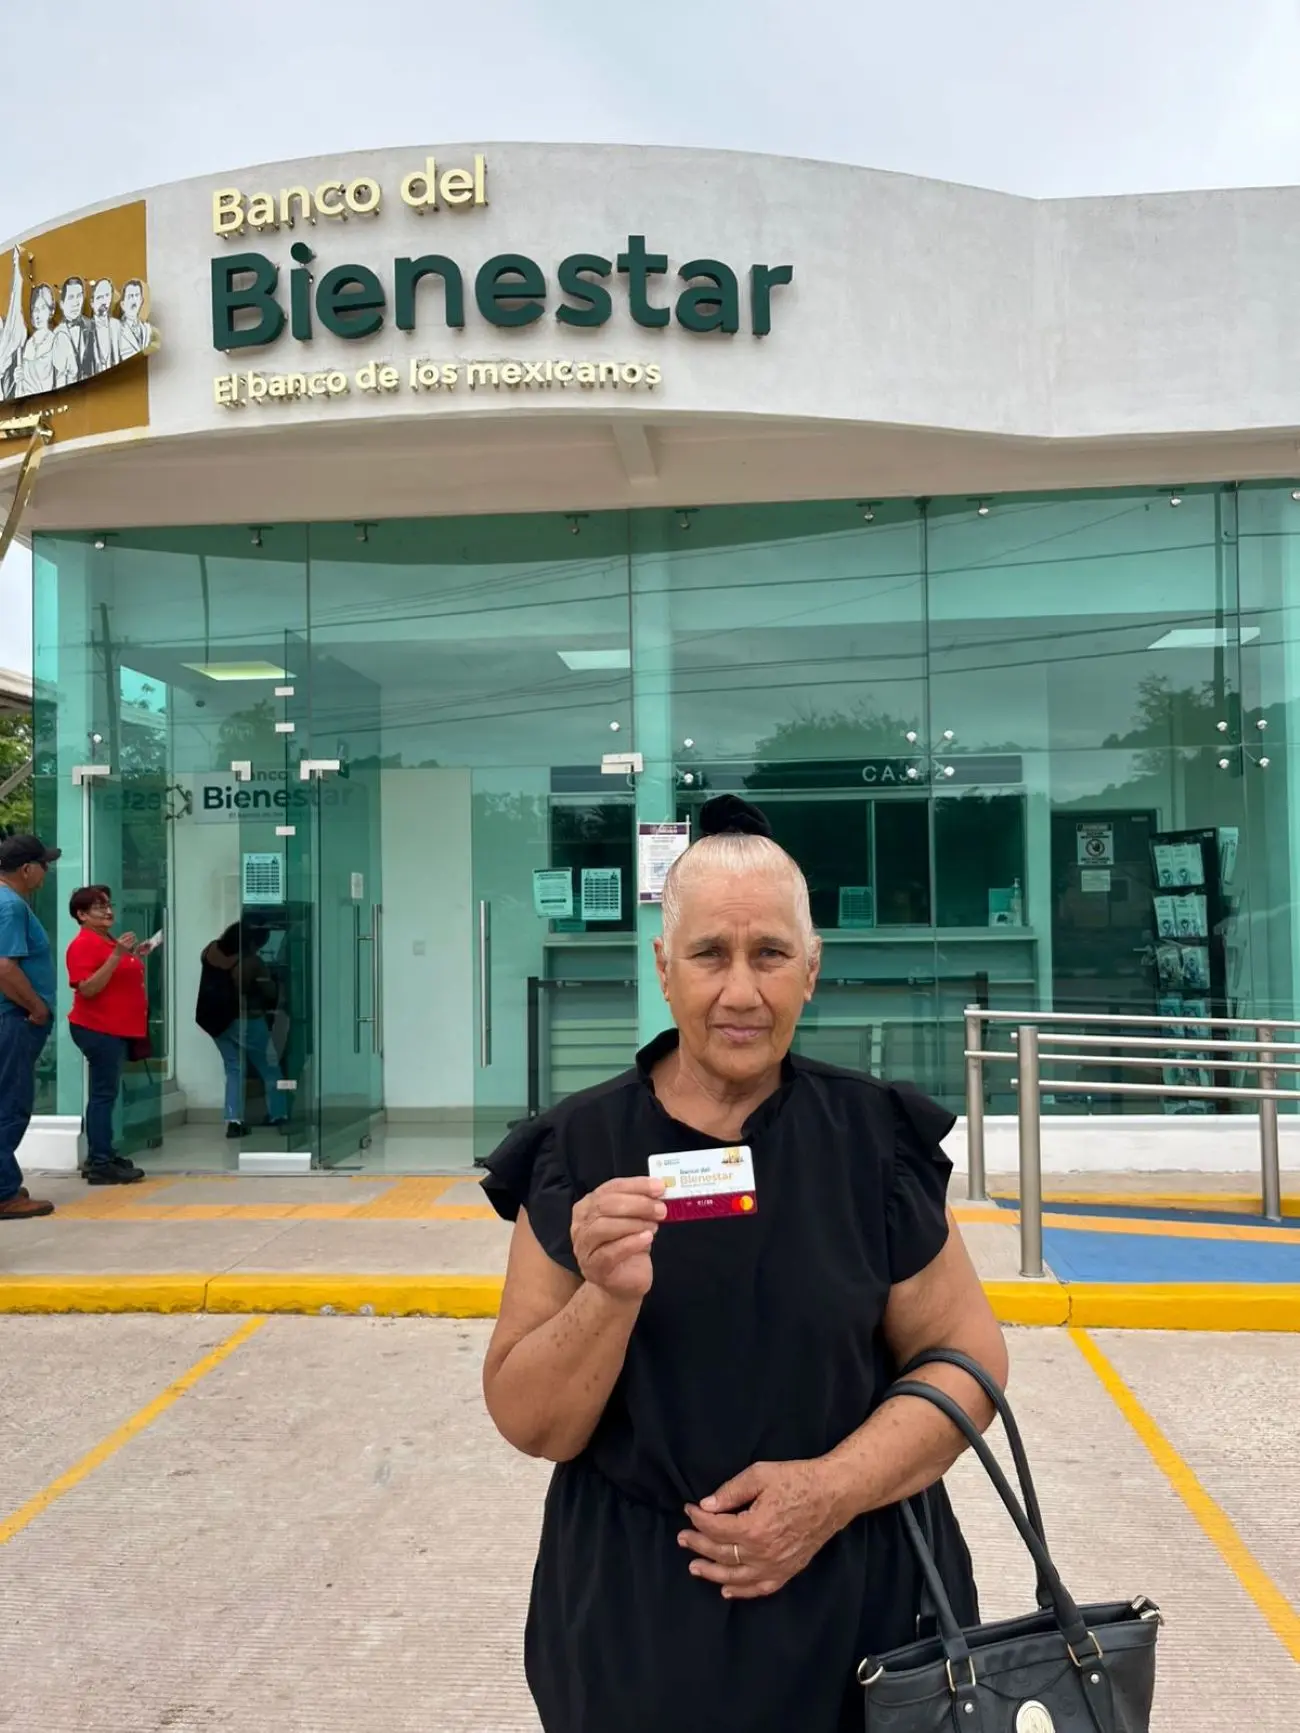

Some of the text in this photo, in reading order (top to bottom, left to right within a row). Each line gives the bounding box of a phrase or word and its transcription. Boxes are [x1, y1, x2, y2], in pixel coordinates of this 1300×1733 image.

[211, 154, 487, 235] Banco del
[210, 234, 794, 351] Bienestar
[213, 358, 662, 405] El banco de los mexicanos
[203, 785, 354, 810] Bienestar
